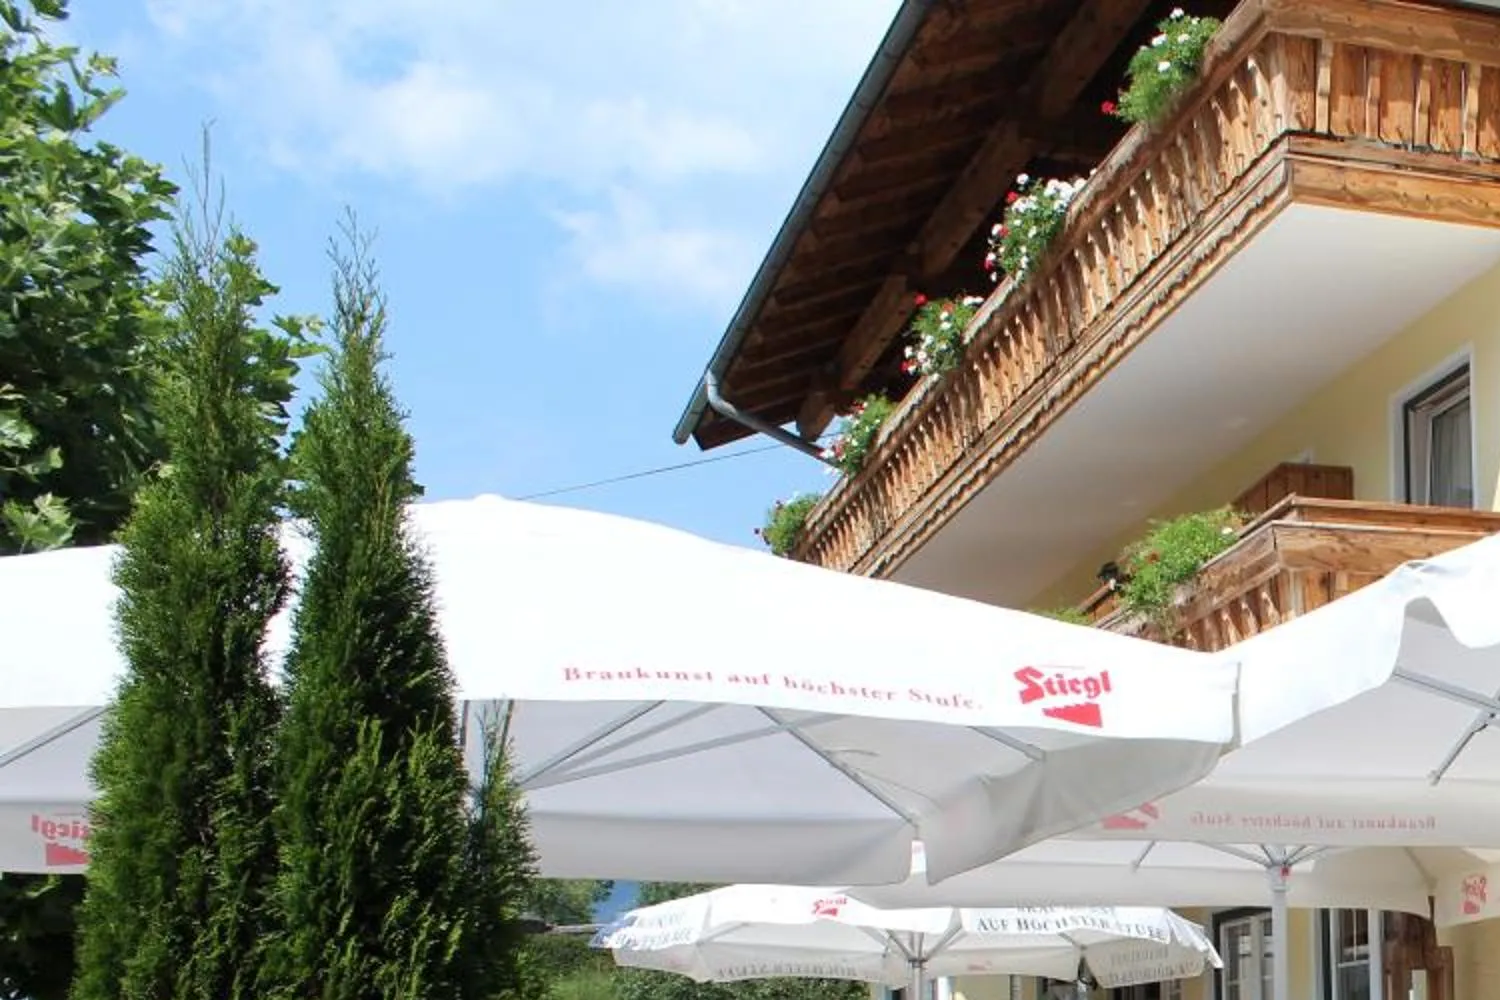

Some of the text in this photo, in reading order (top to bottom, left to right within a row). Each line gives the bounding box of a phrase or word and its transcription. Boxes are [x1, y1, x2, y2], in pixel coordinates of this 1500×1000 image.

[563, 666, 714, 682] Braukunst
[727, 673, 771, 687] auf
[1013, 664, 1113, 706] Stiegl
